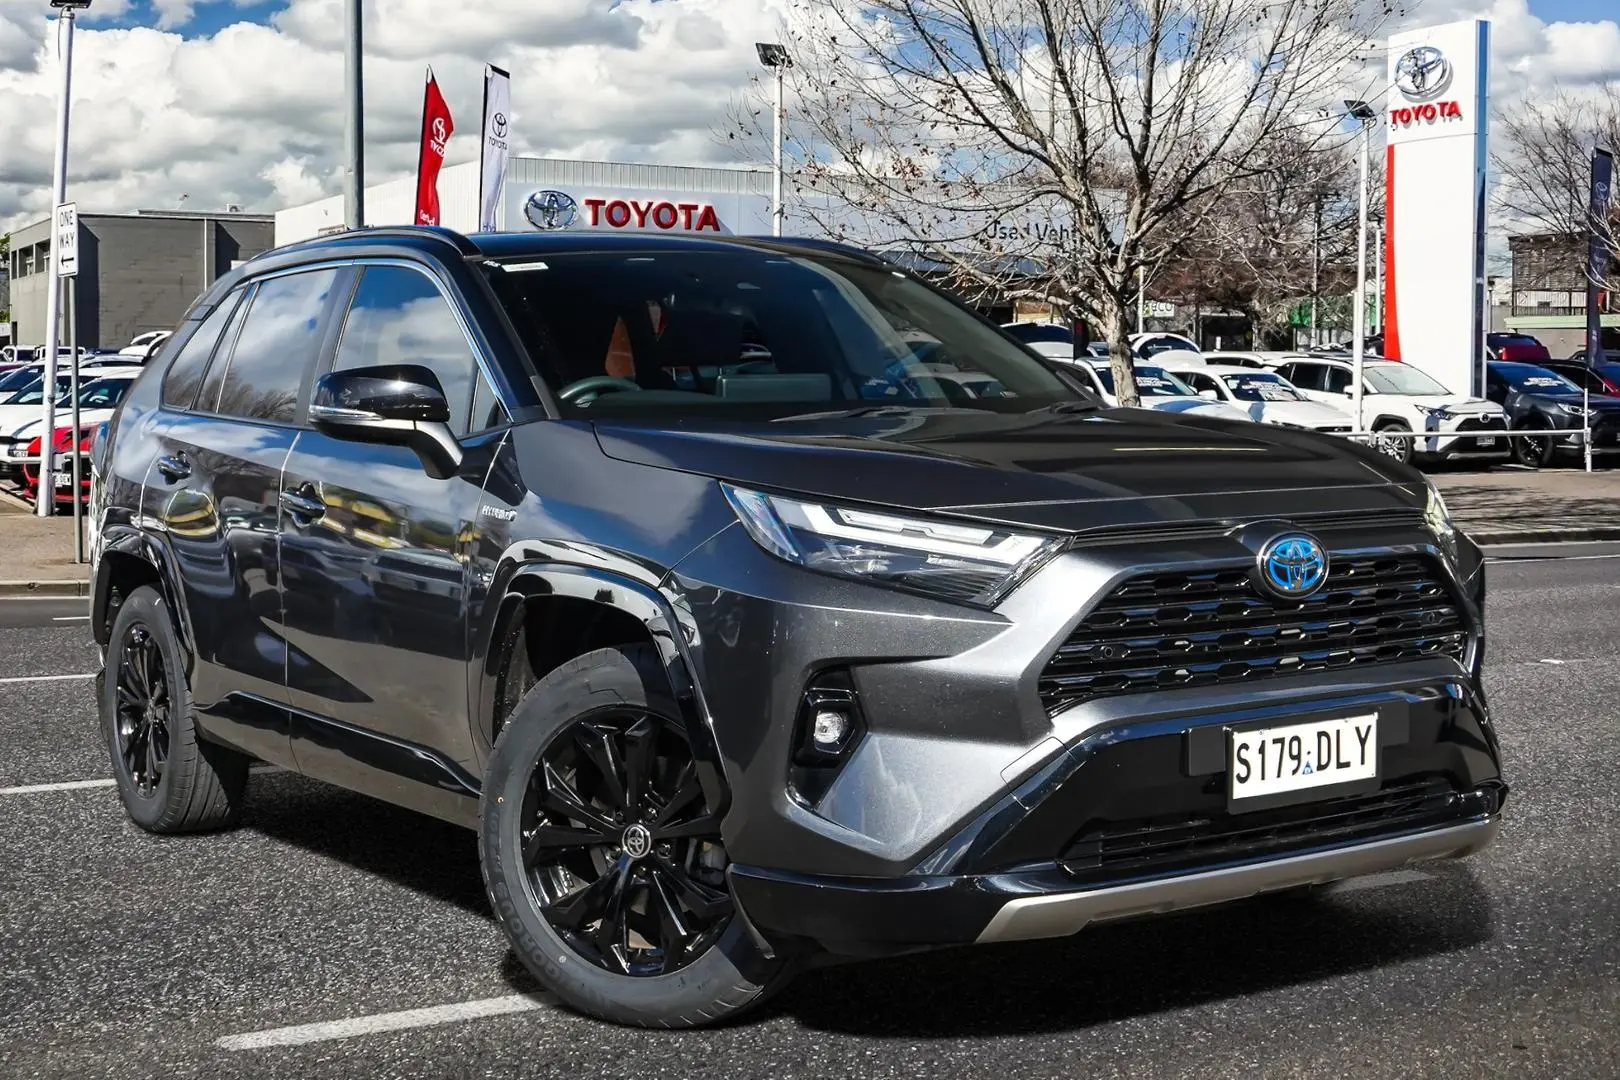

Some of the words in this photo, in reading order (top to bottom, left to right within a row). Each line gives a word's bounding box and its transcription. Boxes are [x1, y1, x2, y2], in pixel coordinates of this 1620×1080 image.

[1390, 101, 1461, 124] TOYOTA
[60, 209, 73, 227] ONE
[585, 199, 721, 231] TOYOTA
[59, 231, 75, 249] WAY
